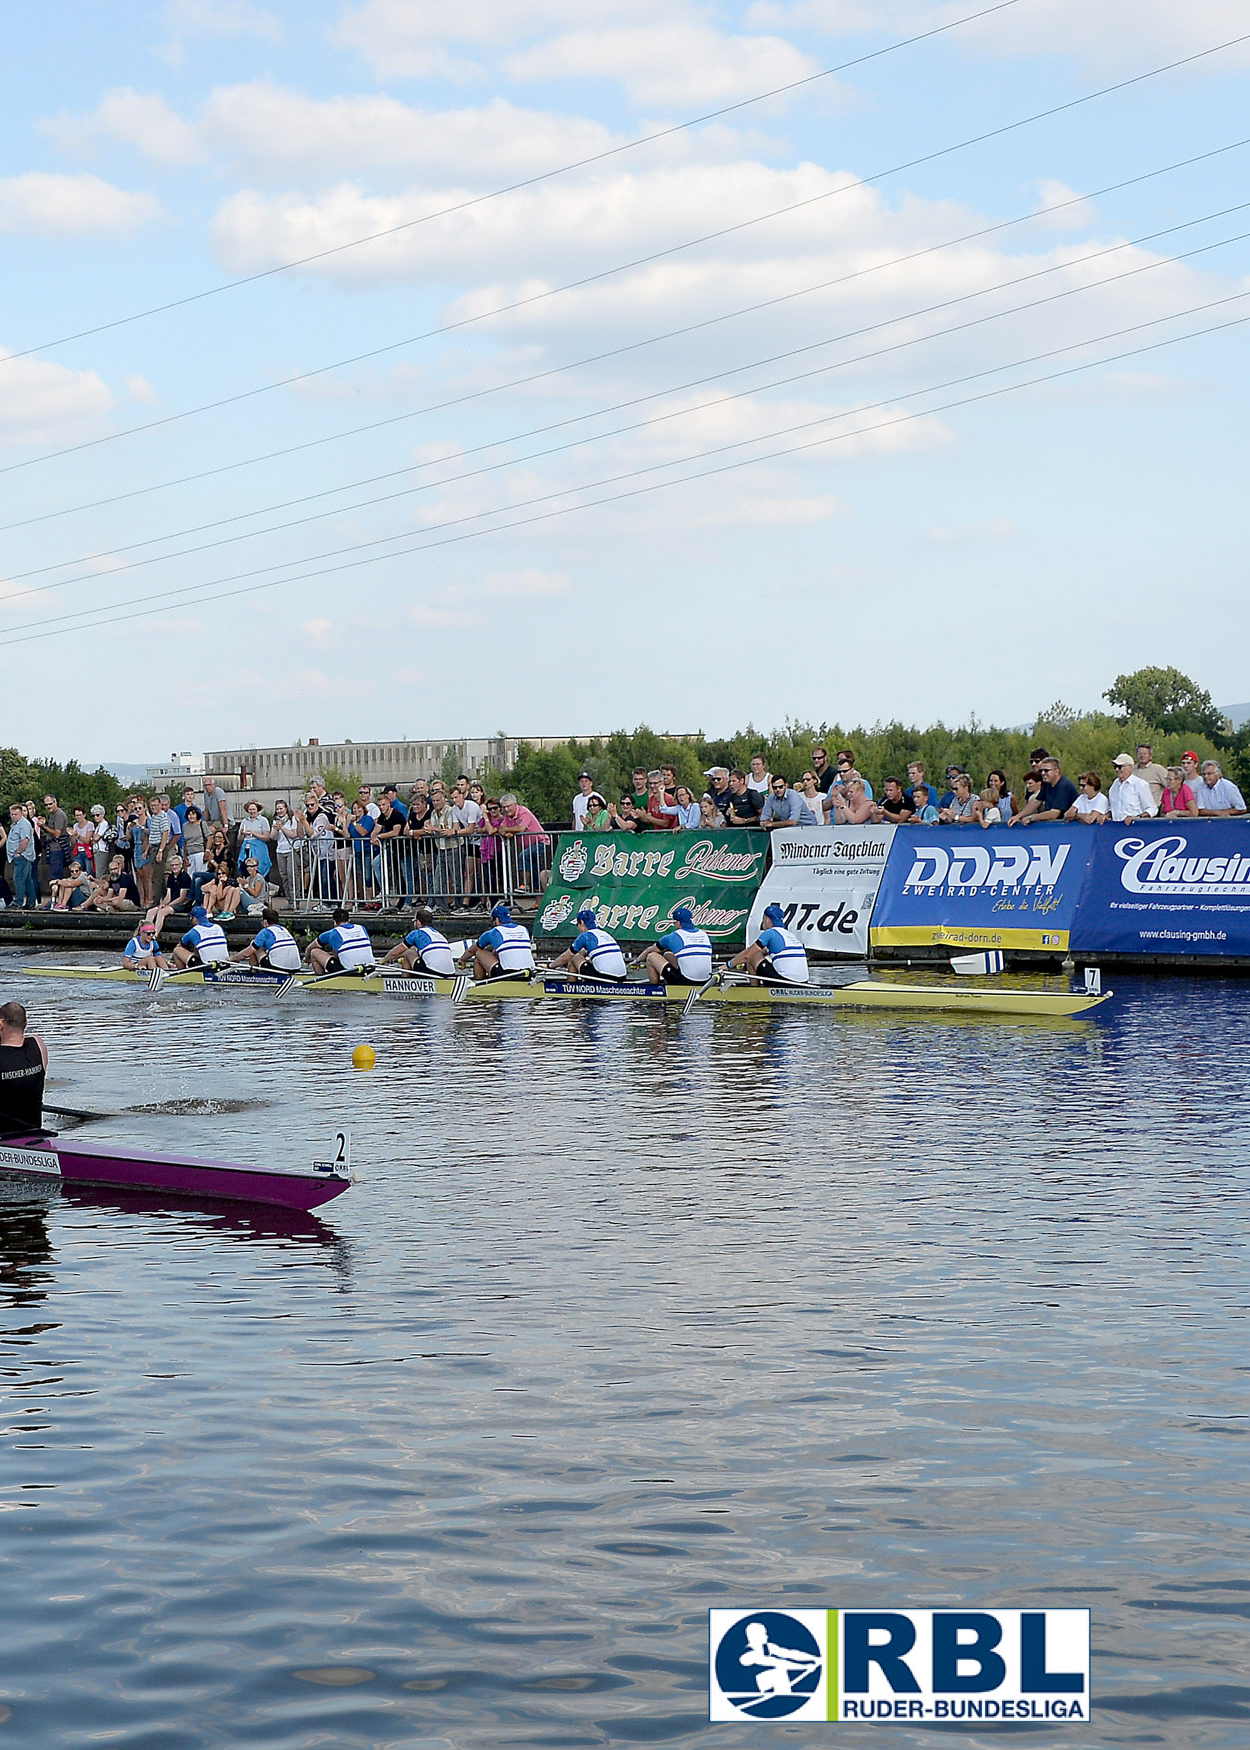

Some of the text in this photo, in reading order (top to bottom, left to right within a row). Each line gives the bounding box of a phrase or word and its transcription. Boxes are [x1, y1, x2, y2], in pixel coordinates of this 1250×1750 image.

[780, 840, 886, 860] Mindener Tageblatt
[590, 840, 763, 881] Barre Pilsener
[904, 844, 1071, 886] DORN
[813, 868, 833, 877] Täglich
[901, 885, 1055, 897] ZWEIRAD-CENTER
[1139, 884, 1250, 893] Fahrzeugtechn
[991, 899, 1015, 913] Erlebe
[932, 932, 1002, 943] zweirad-dorn.de
[1139, 929, 1227, 941] www.clausing-gmbh.de
[1089, 970, 1096, 986] 7
[385, 980, 435, 992] HANNOVER
[562, 983, 576, 993] TÜV
[576, 984, 596, 993] NORD
[335, 1132, 346, 1162] 2
